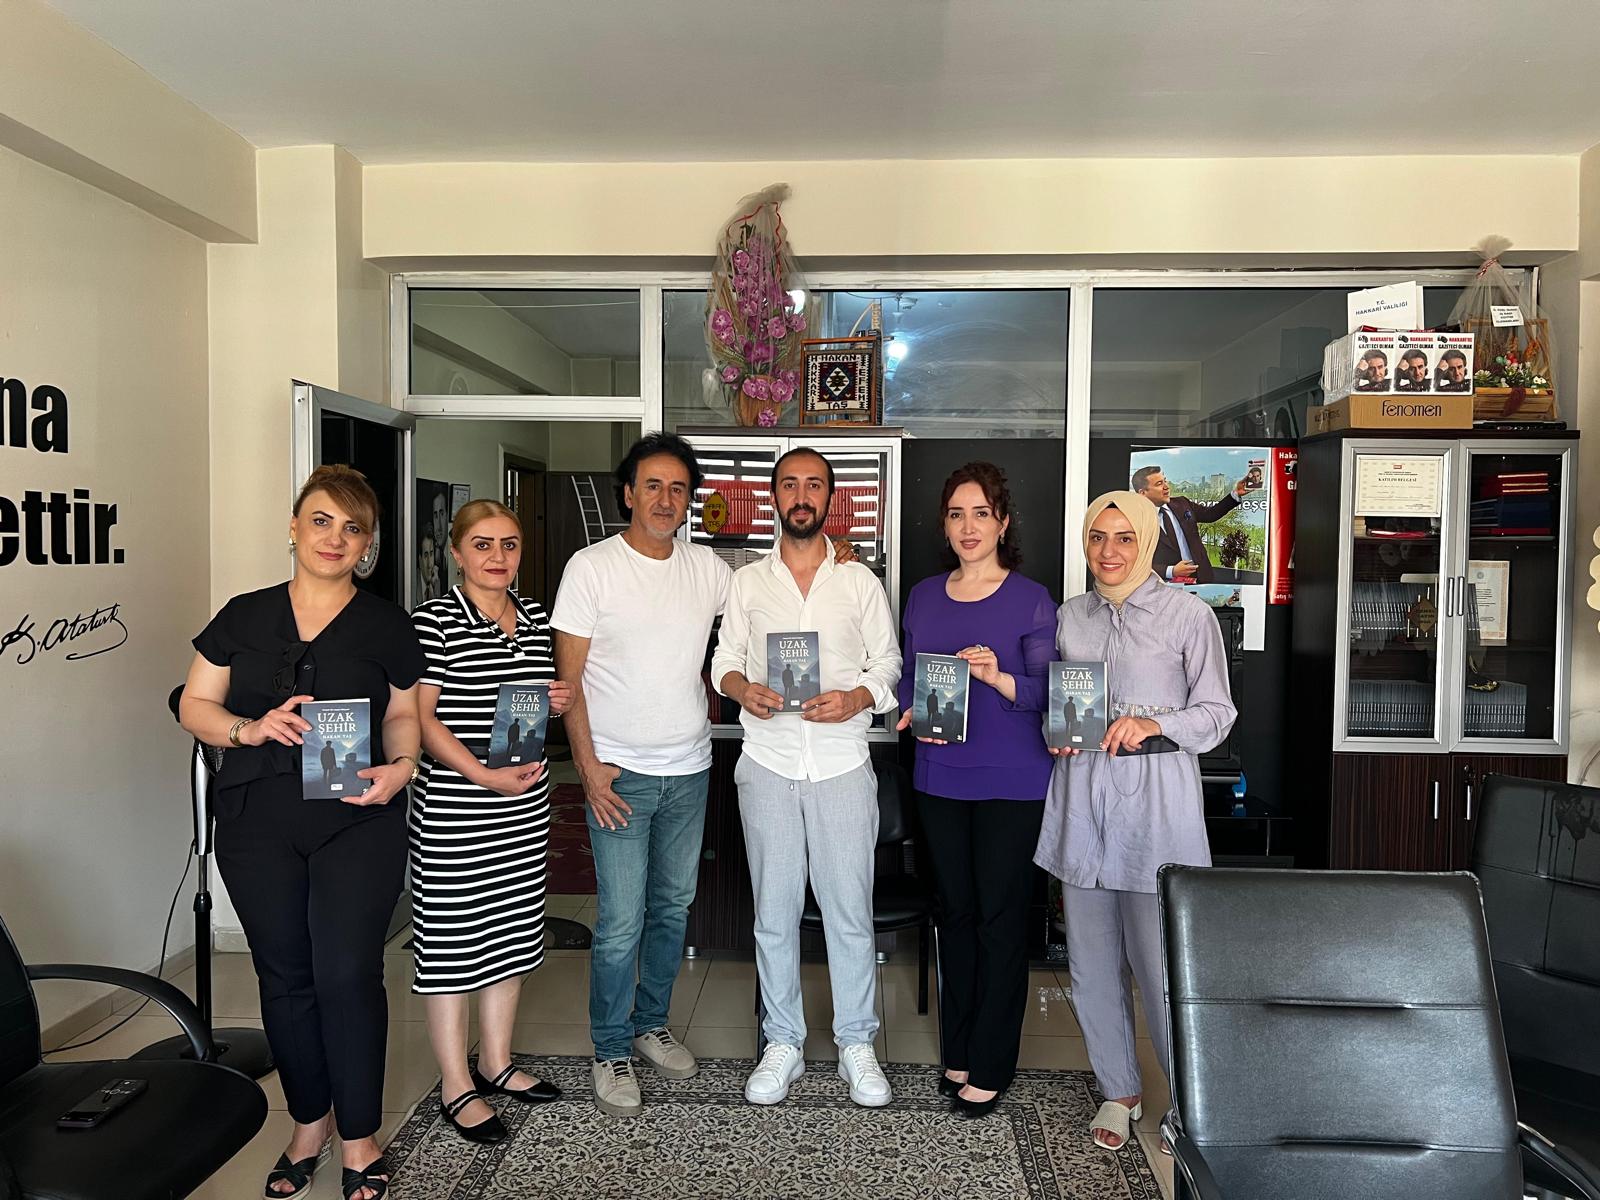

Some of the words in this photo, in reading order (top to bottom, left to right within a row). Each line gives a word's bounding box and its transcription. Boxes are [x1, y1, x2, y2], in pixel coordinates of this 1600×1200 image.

[1355, 305, 1382, 316] HAKKARİ
[1383, 300, 1408, 310] VALİLİĞİ
[821, 354, 856, 362] HAKAN
[1381, 400, 1442, 417] fenomen
[779, 640, 808, 649] UZAK
[780, 648, 809, 659] ŞEHİR
[927, 664, 956, 675] UZAK
[927, 673, 957, 684] ŞEHİR
[1061, 671, 1093, 680] UZAK
[1062, 680, 1095, 690] ŞEHİR
[512, 693, 540, 703] UZAK
[510, 702, 540, 713] ŞEHİR
[317, 712, 355, 723] UZAK
[318, 721, 357, 735] ŞEHİR
